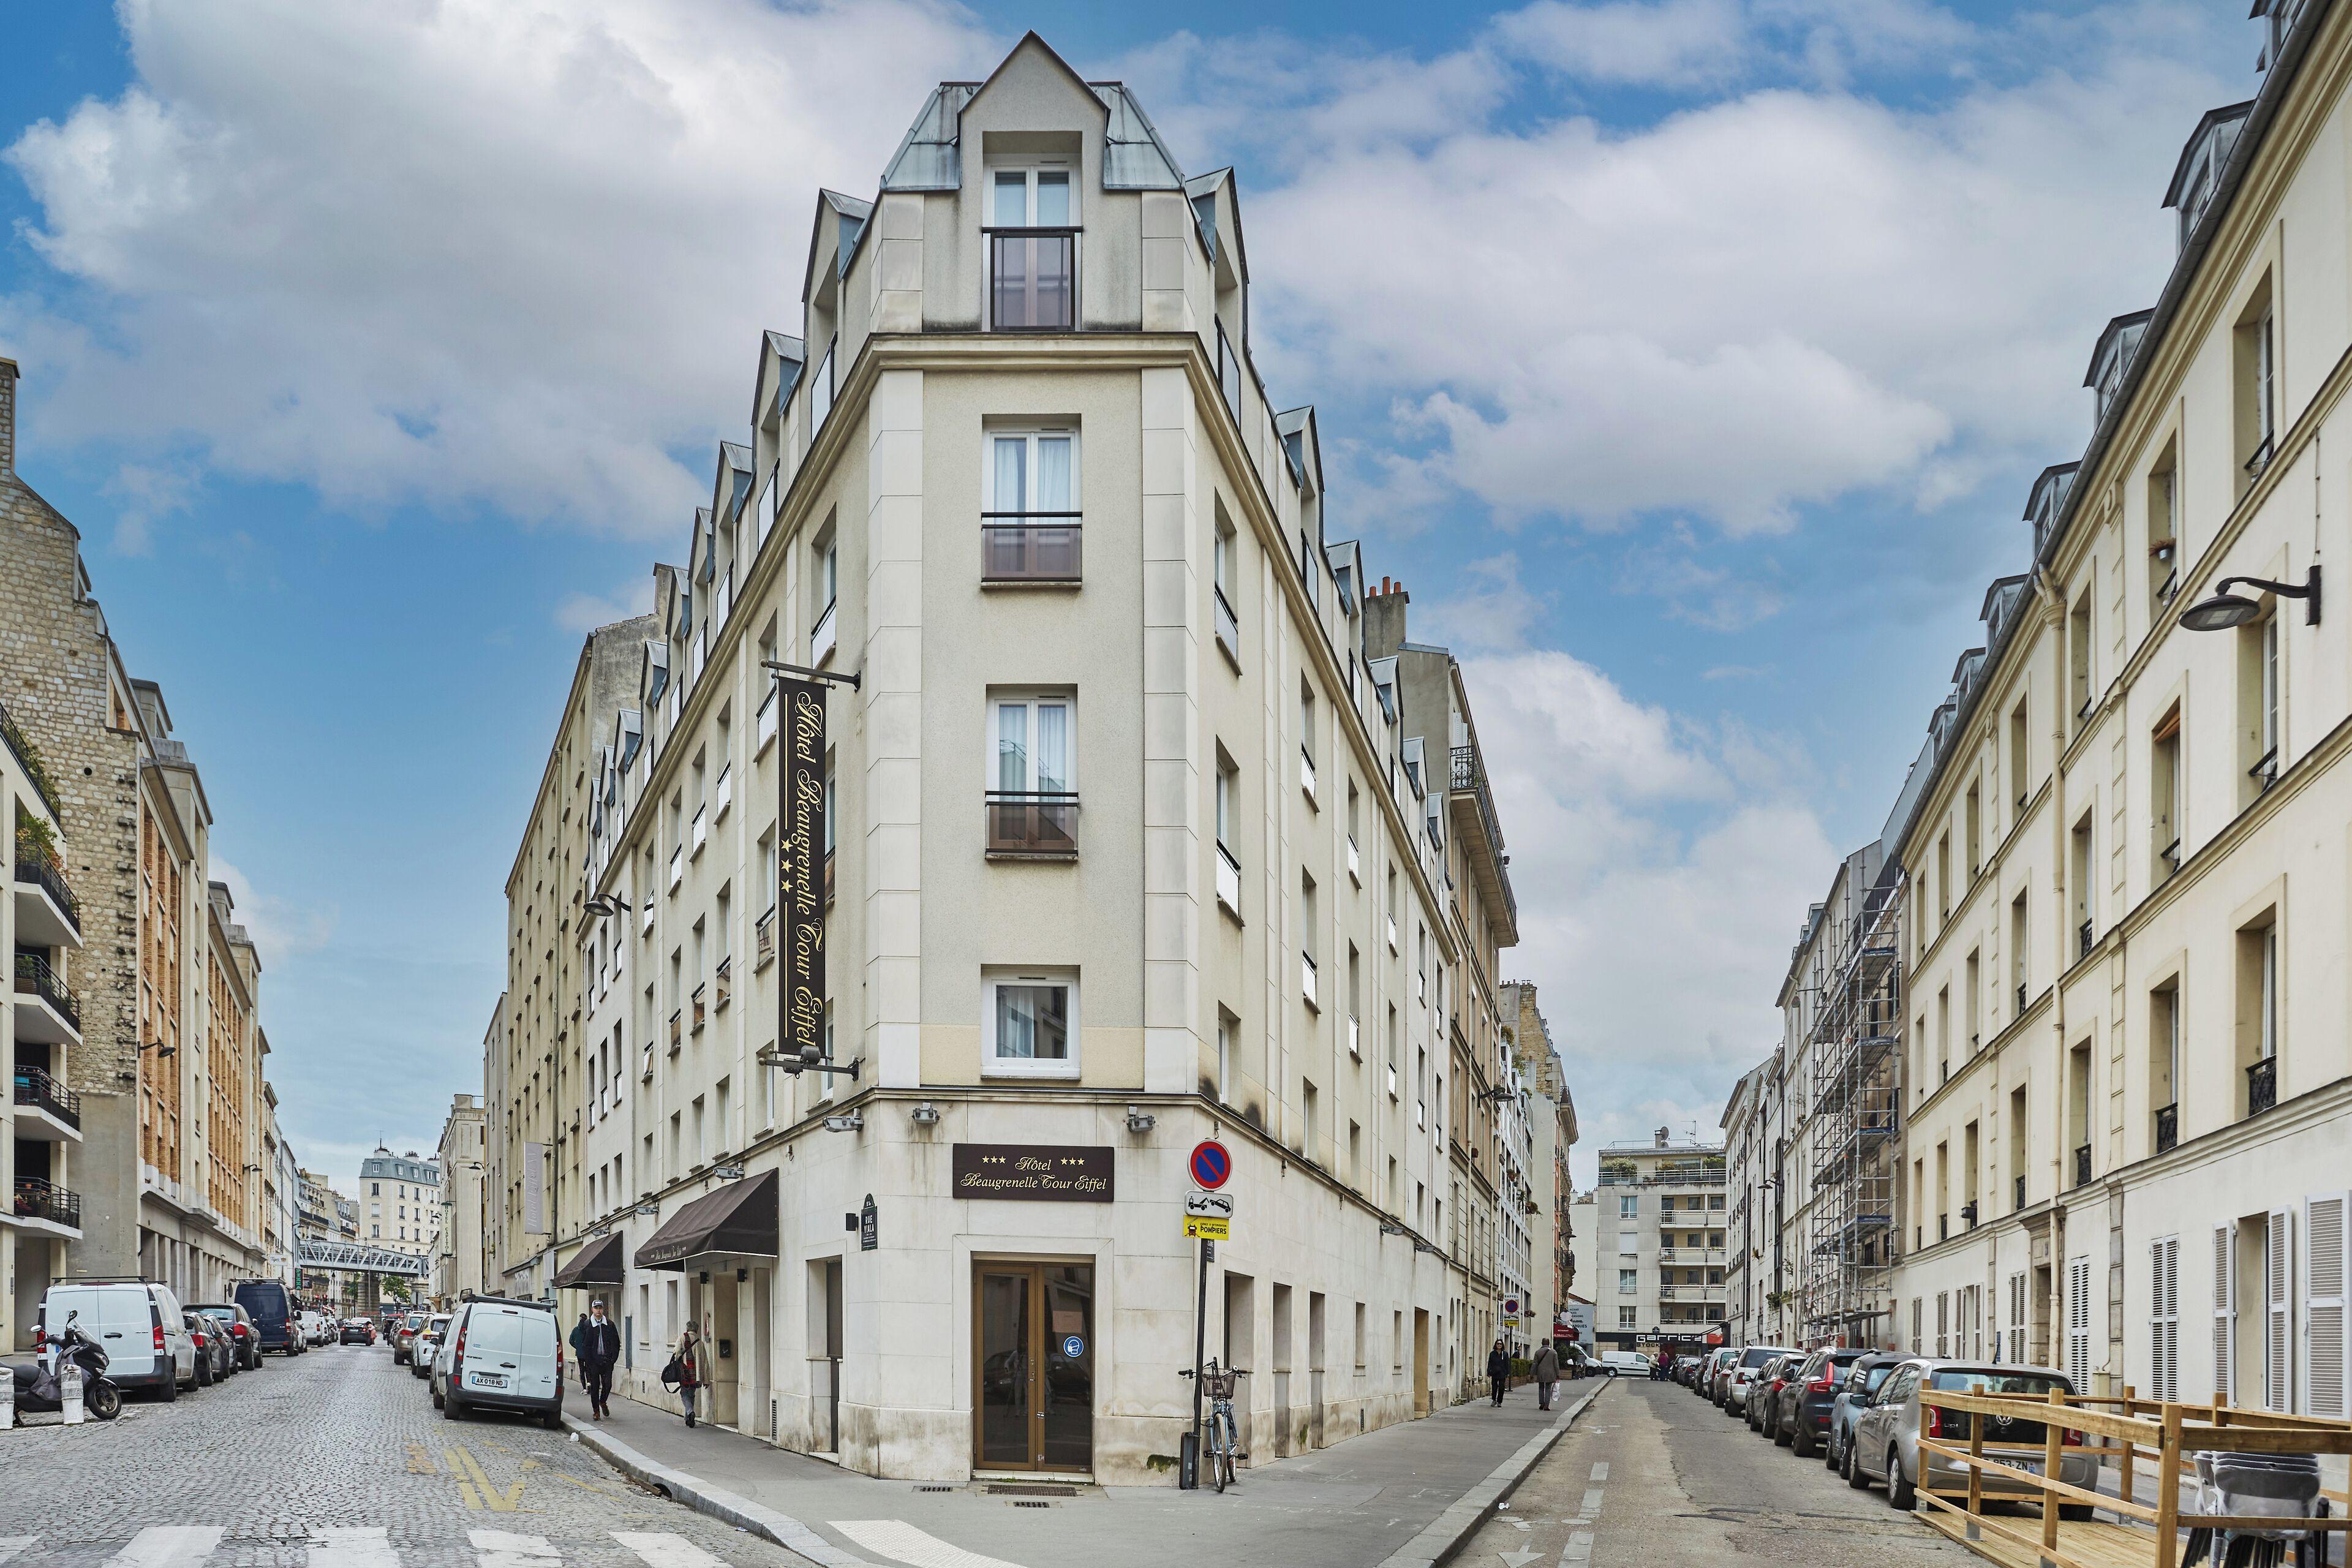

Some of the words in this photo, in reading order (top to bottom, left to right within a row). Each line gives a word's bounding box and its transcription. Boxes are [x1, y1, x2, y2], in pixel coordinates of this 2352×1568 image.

[795, 692, 823, 764] Hôtel
[791, 769, 823, 915] Beaugrenelle
[796, 918, 823, 980] Tour
[791, 986, 823, 1047] Eiffel
[960, 1172, 1038, 1190] Beaugrenelle
[1038, 1174, 1072, 1189] Tour
[1074, 1175, 1107, 1192] Eiffel
[1015, 1156, 1052, 1170] Hôtel
[1200, 1225, 1227, 1234] POMPIERS
